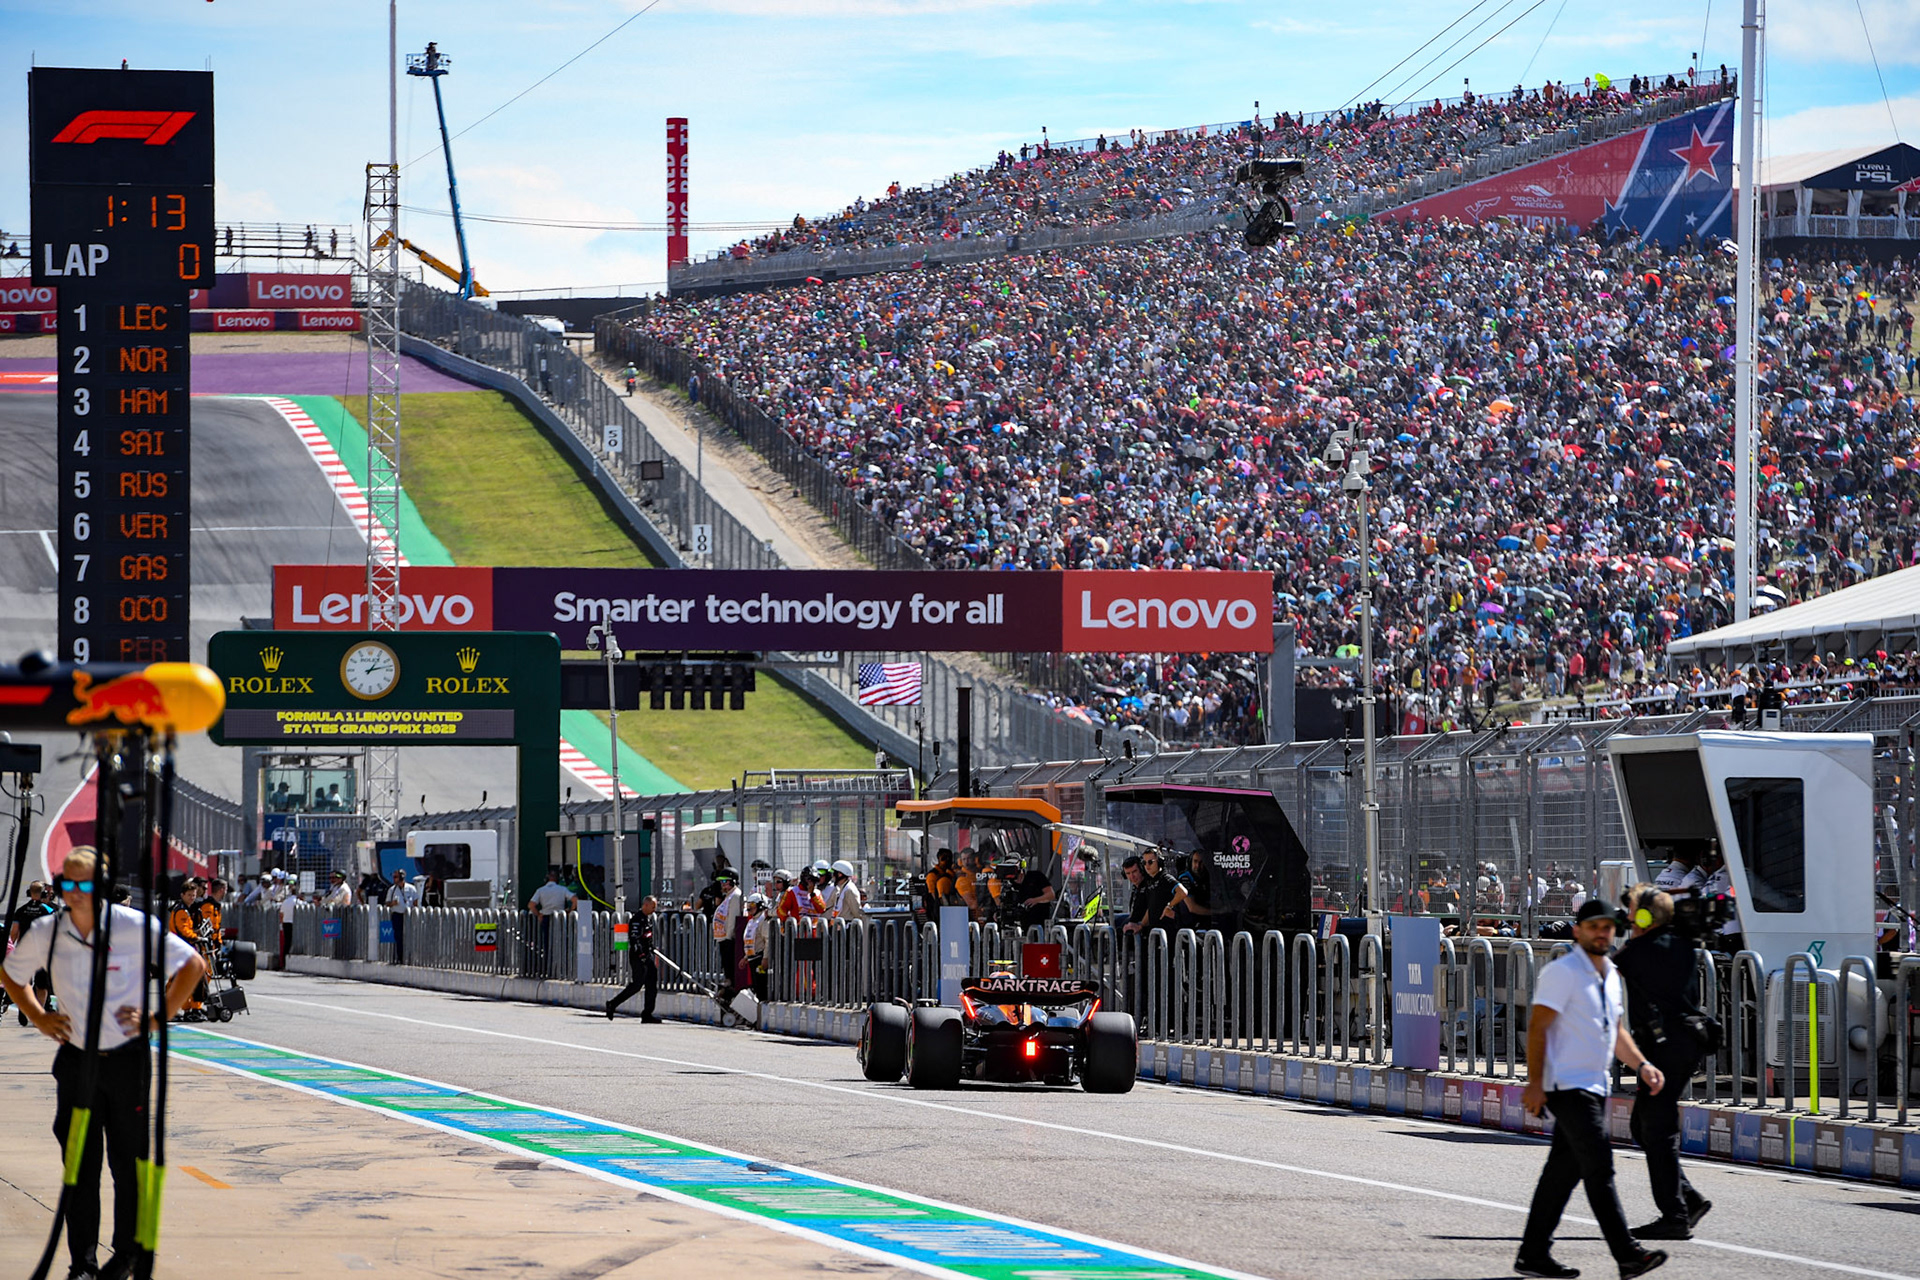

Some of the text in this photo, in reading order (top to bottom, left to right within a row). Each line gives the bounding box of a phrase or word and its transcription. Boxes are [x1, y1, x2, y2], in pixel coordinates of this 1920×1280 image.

[1855, 171, 1899, 183] PSL
[107, 195, 186, 231] 1:13
[1515, 201, 1565, 209] AMERICAS
[44, 243, 200, 280] LAP 0
[257, 280, 344, 300] Lenovo
[73, 304, 86, 331] 1
[120, 305, 168, 330] LEC
[217, 315, 270, 328] Lenovo
[302, 315, 353, 327] Lenovo
[73, 346, 168, 374] 2 NOR
[73, 388, 168, 416] 3 HAM
[73, 430, 164, 456] 4 SAI
[73, 471, 168, 498] 5 RUS
[73, 513, 168, 541] 6 VER
[73, 555, 168, 581] 7 GAS
[73, 596, 167, 624] 8 OCO
[292, 585, 474, 625] Lenovo
[553, 592, 1003, 630] Smarter technology for all
[1081, 590, 1257, 628] Lenovo
[73, 638, 90, 666] 9
[229, 677, 314, 694] ROLEX
[426, 677, 510, 694] ROLEX
[276, 711, 344, 722] FORMULA
[355, 711, 412, 722] LENOVO
[413, 711, 463, 722] UNITED
[283, 723, 456, 734] STATES GRAND PRIX 2023
[273, 831, 297, 842] FIA
[981, 978, 1081, 993] DARKTRACE
